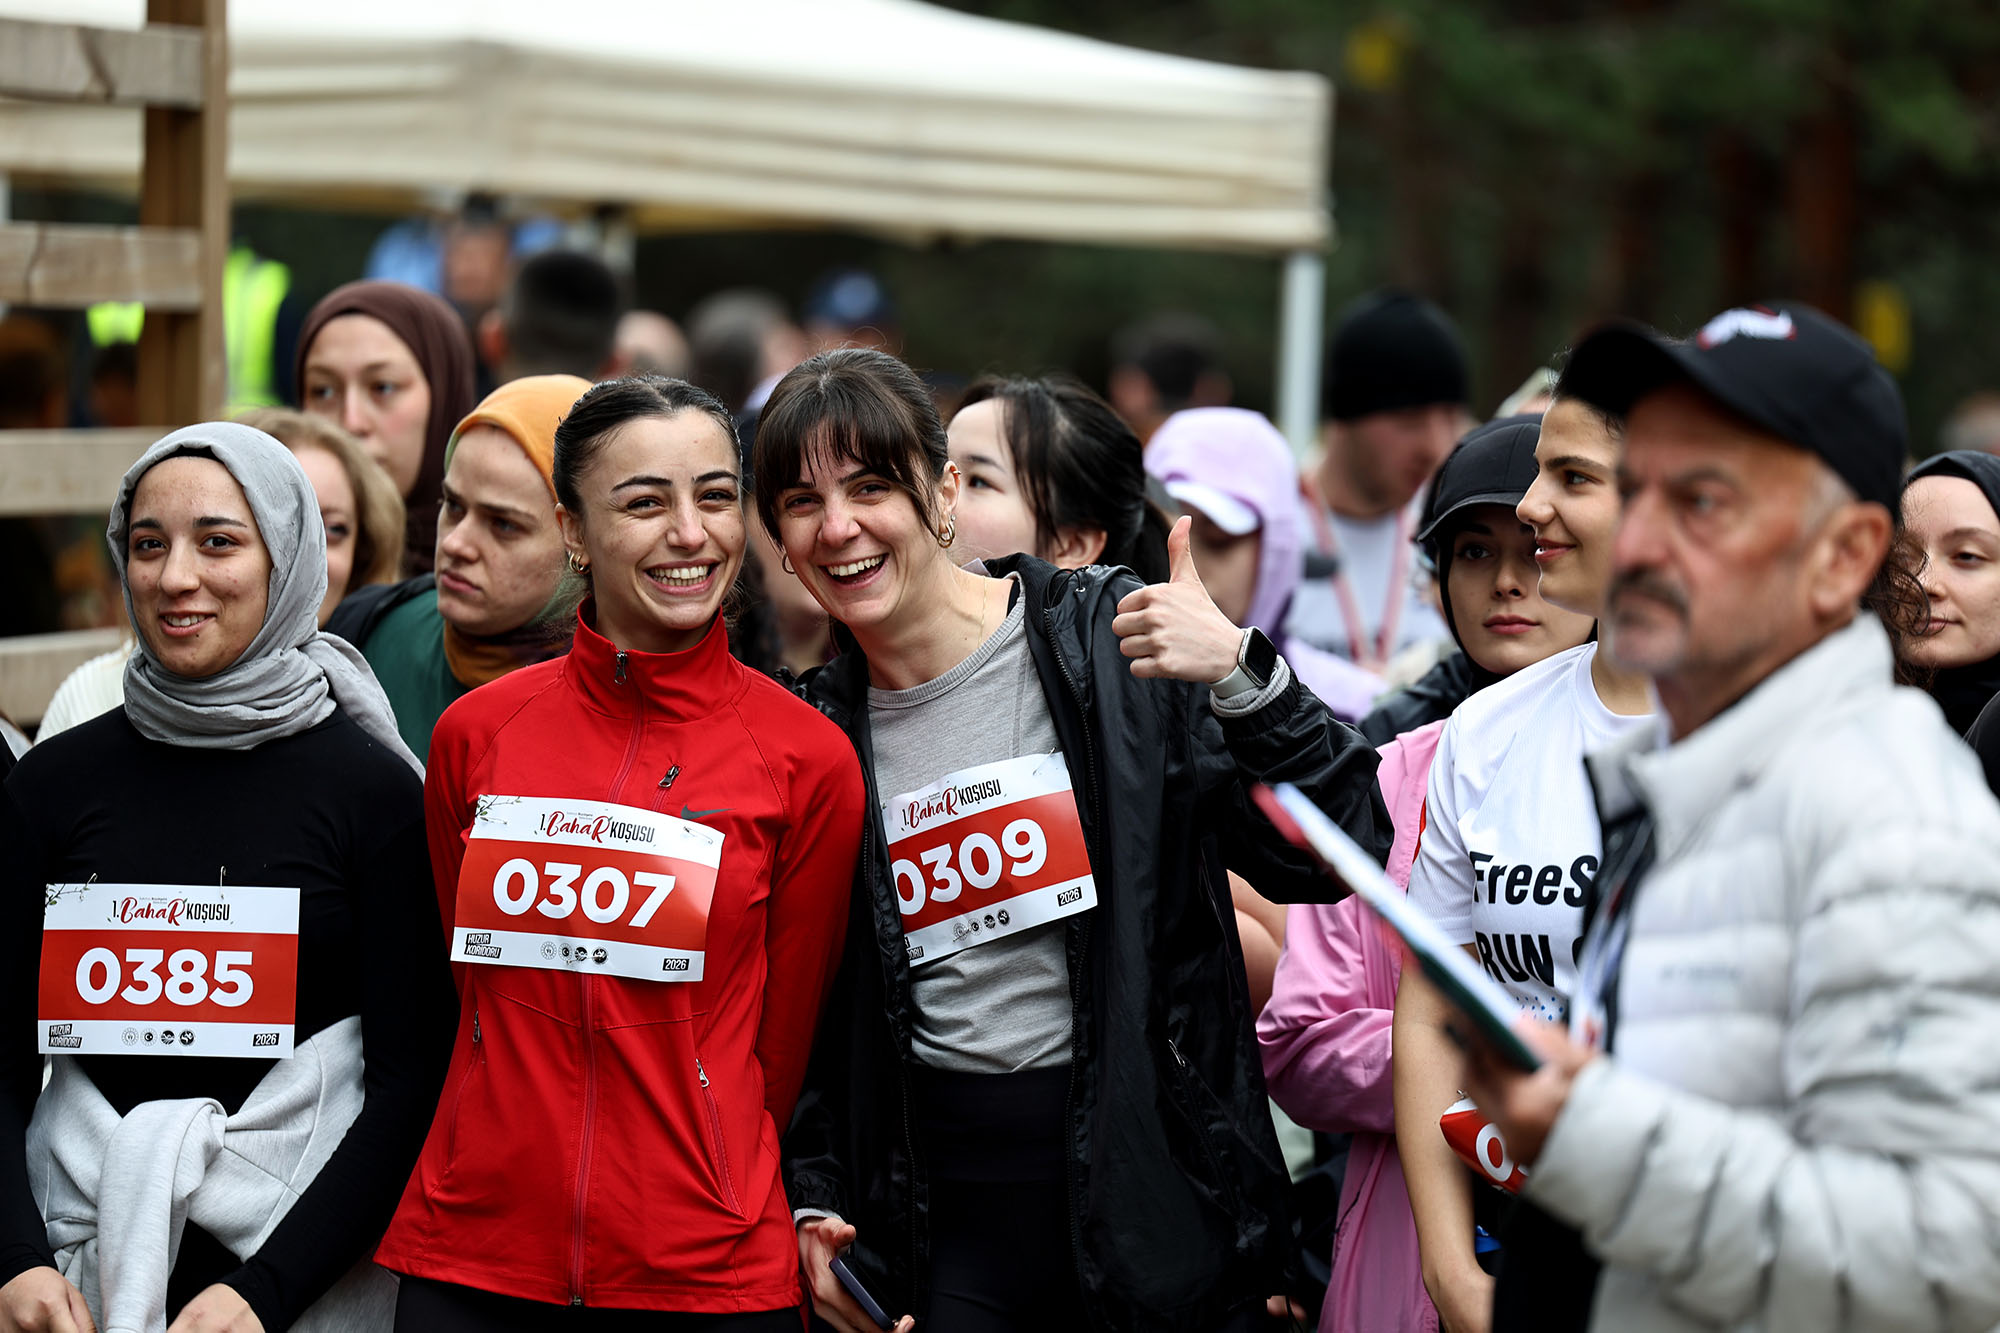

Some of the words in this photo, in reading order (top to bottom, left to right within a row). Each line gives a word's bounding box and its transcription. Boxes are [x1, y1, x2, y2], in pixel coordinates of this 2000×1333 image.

[957, 778, 1002, 807] KOŞUSU
[609, 821, 655, 844] KOŞUSU
[891, 818, 1048, 915] 0309
[493, 858, 677, 929] 0307
[1058, 890, 1080, 905] 2026
[186, 902, 230, 924] KOŞUSU
[467, 933, 490, 945] HUZUR
[664, 959, 687, 971] 2026
[1475, 931, 1555, 987] RUN
[75, 947, 254, 1008] 0385
[50, 1024, 72, 1037] HUZUR
[254, 1034, 278, 1046] 2026
